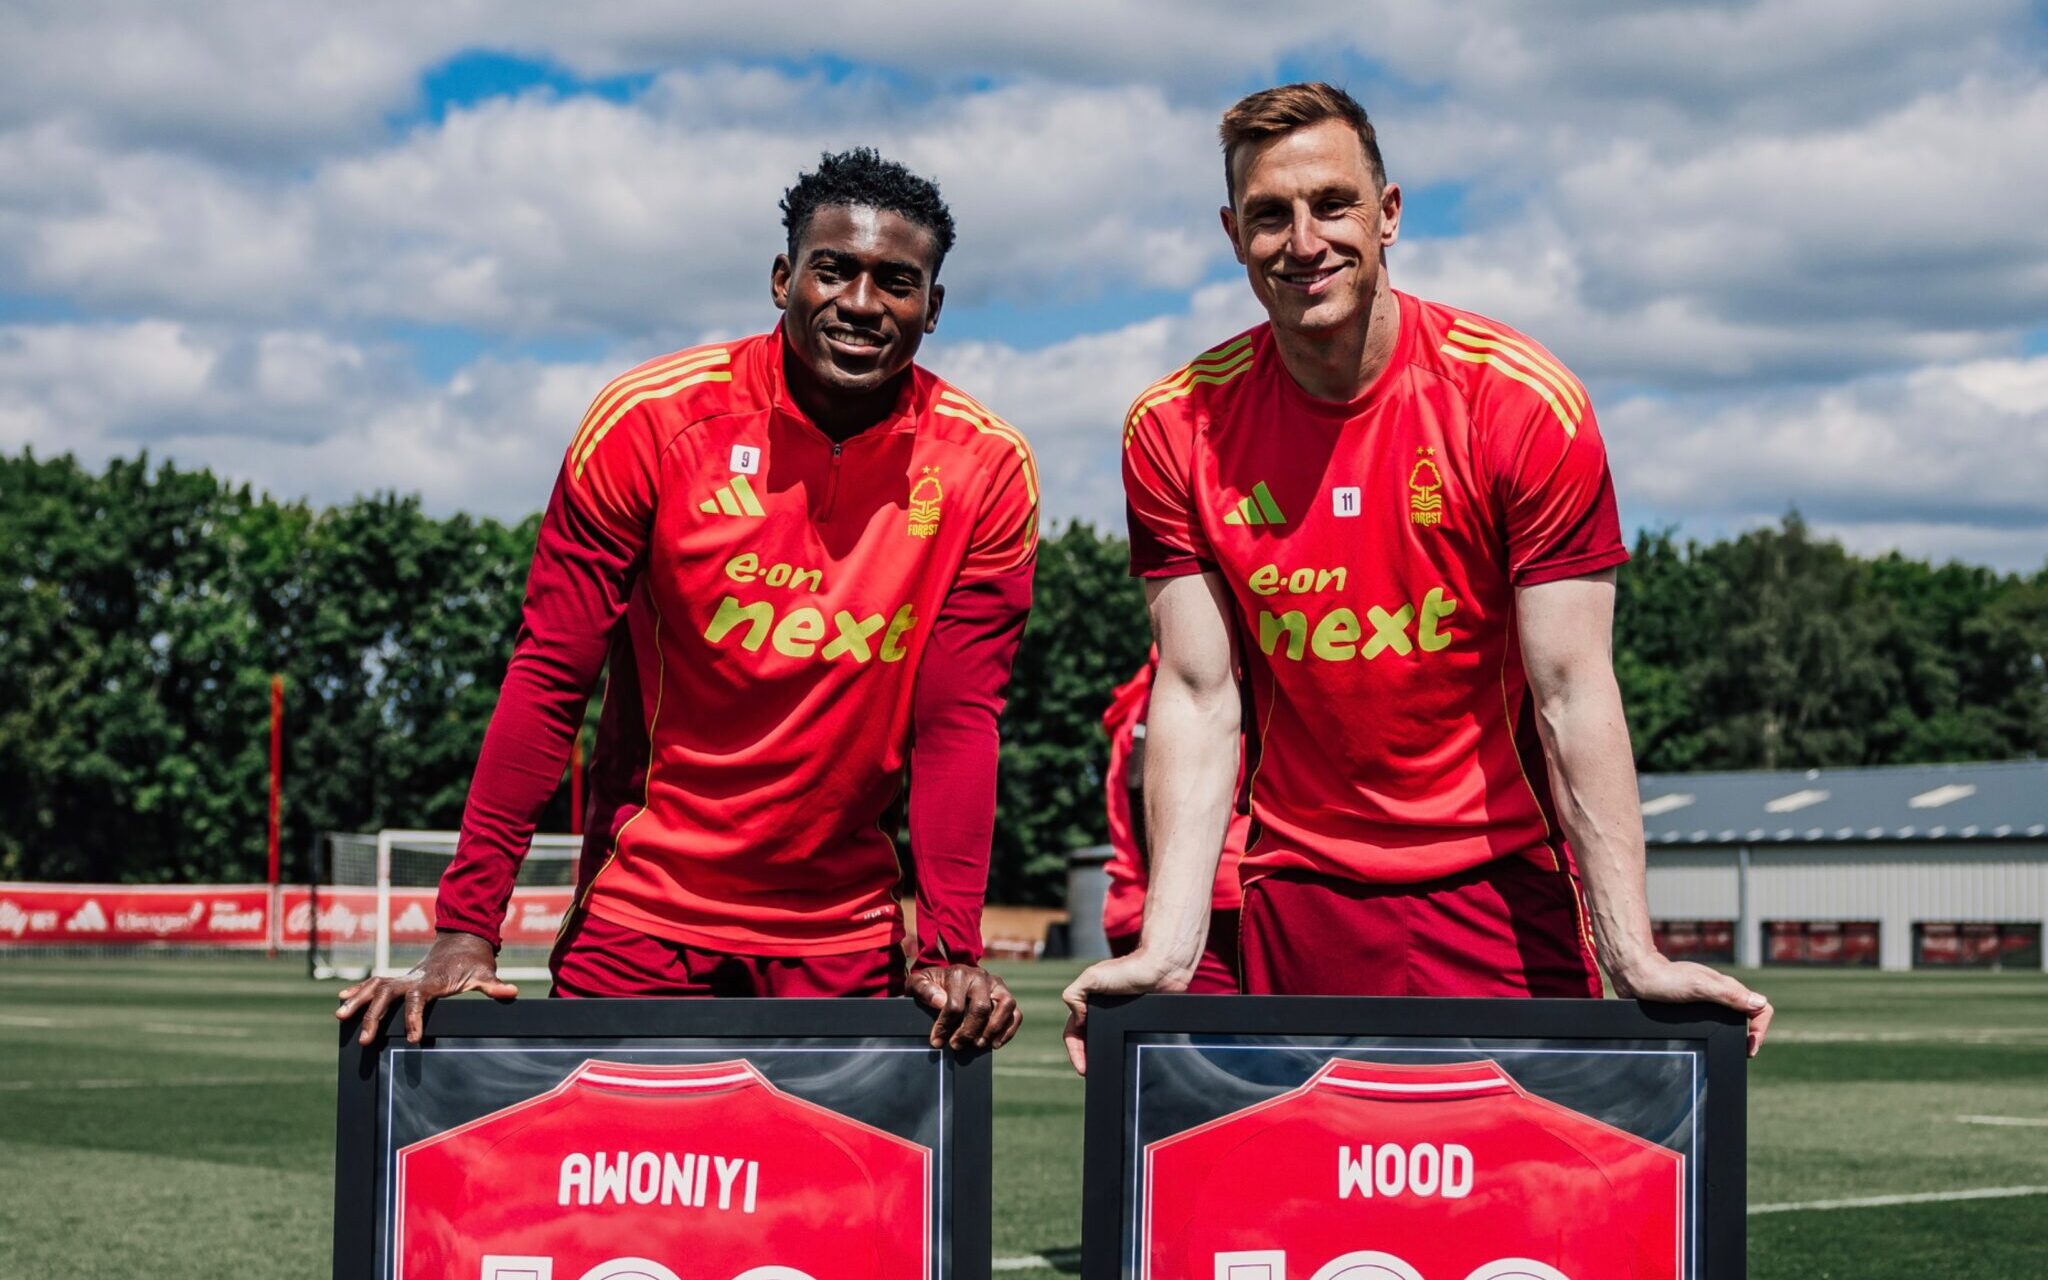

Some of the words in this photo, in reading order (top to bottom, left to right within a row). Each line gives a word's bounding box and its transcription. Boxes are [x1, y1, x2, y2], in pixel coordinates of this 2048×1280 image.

[740, 451, 751, 468] 9
[1341, 492, 1353, 511] 11
[703, 596, 918, 663] next
[1259, 587, 1457, 661] next
[558, 1151, 759, 1213] AWONIYI
[1338, 1142, 1474, 1199] WOOD
